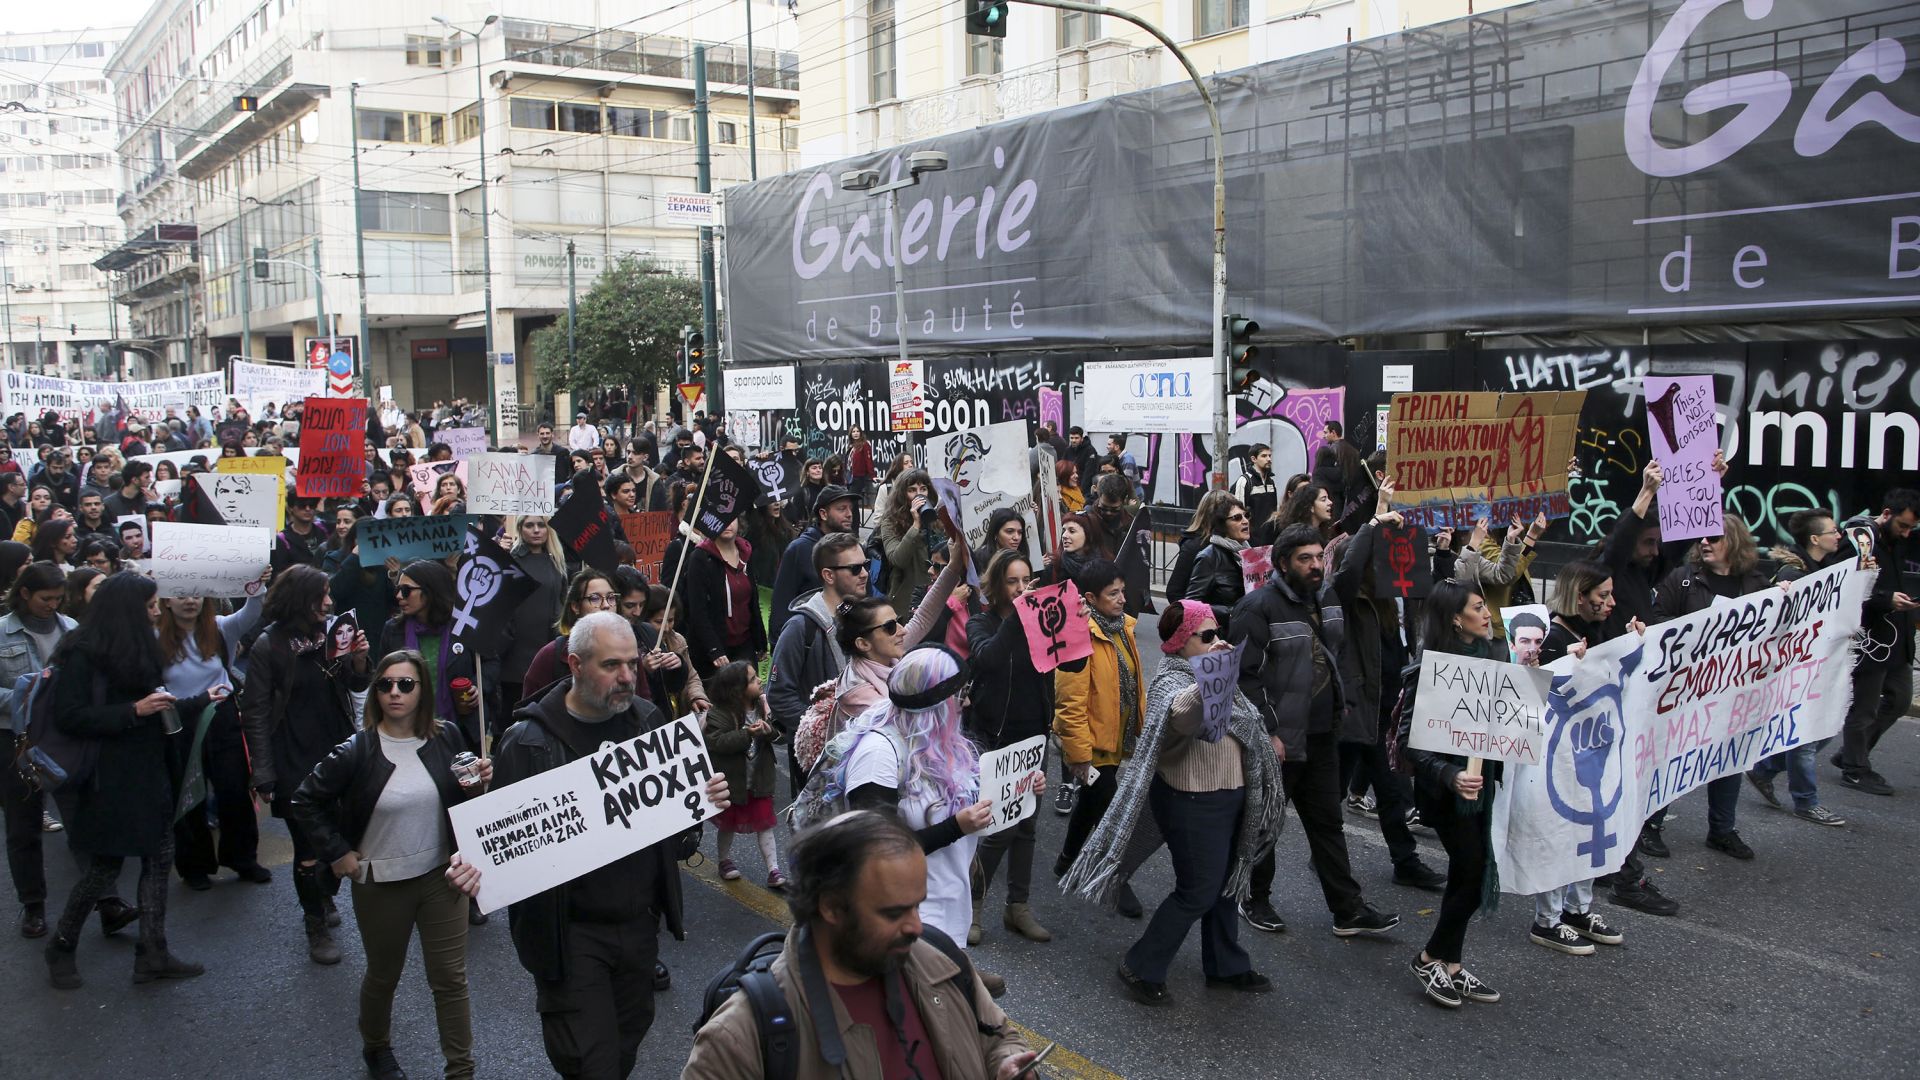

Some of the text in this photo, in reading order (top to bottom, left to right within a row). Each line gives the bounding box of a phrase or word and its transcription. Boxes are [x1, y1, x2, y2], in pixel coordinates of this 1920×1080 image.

[667, 203, 712, 213] ΣΕΡΑΝΗΣ
[668, 196, 711, 204] ΣΚΑΛΩΣΙΕΣ
[792, 146, 1038, 279] Galerie
[1660, 235, 1768, 293] de
[806, 290, 1026, 342] de Bauté
[8, 373, 20, 389] ΟΙ
[25, 376, 76, 393] ΓΥΝΑΙΚΕΣ
[734, 372, 783, 390] spanopoulos
[34, 394, 71, 407] ΑΜΟΙΒΗ
[1397, 394, 1470, 423] ΤΡΙΠΛΗ
[1674, 393, 1695, 416] This
[1686, 400, 1710, 424] NOT
[303, 406, 345, 431] WITCH
[924, 398, 991, 434] soon
[320, 433, 351, 452] NOT
[1397, 422, 1510, 455] ΓΥΝΑΙΚΟΚΤΟΝΙΑ
[1679, 413, 1716, 449] consent
[301, 455, 362, 475] THE RICH
[477, 461, 531, 482] ΚΑΜΙΑ
[1394, 455, 1492, 491] ΣΤΟΝ ΕΒΡΟ
[306, 477, 352, 495] BURN
[491, 479, 547, 499] ΑΝΟΧΗ
[489, 500, 553, 514] ΣΕΞΙΣΜΟ
[1443, 503, 1475, 527] THE
[368, 524, 458, 549] ΤΑ ΜΑΛΛΙΑ
[432, 540, 461, 553] ΜΑΣ
[574, 523, 600, 552] ΚΑΜΙΑ
[158, 545, 188, 563] love
[1648, 623, 1693, 682] ΣΕ
[1770, 569, 1847, 635] ΜΟΡΦΗ
[1433, 661, 1520, 700] ΚΑΜΙΑ
[1657, 620, 1823, 715] ΕΜΦΥΛΗΣ ΒΙΑΣ
[1451, 697, 1540, 733] ΑΝΟΧΗ
[1664, 701, 1719, 761] ΜΑΣ
[590, 720, 702, 791] ΚΑΜΙΑ
[1452, 731, 1535, 761] ΠΑΤΡΙΑΡΧΙΑ
[1646, 703, 1802, 815] ΑΠΕΝΑΝΤΙ ΣΑΣ
[995, 744, 1043, 779] MY DRESS
[604, 753, 712, 829] ΑΝΟΧΗ
[1001, 771, 1036, 801] IS NOT
[476, 790, 578, 838] Η ΚΑΝΟΝΙΚΟΤΗΤΑ ΣΑΣ
[541, 806, 581, 832] ΑΙΜΑ
[1002, 796, 1024, 824] YES
[492, 817, 588, 866] ΕΙΜΑΣΤΕ ΟΛΑ ΖΑΚ
